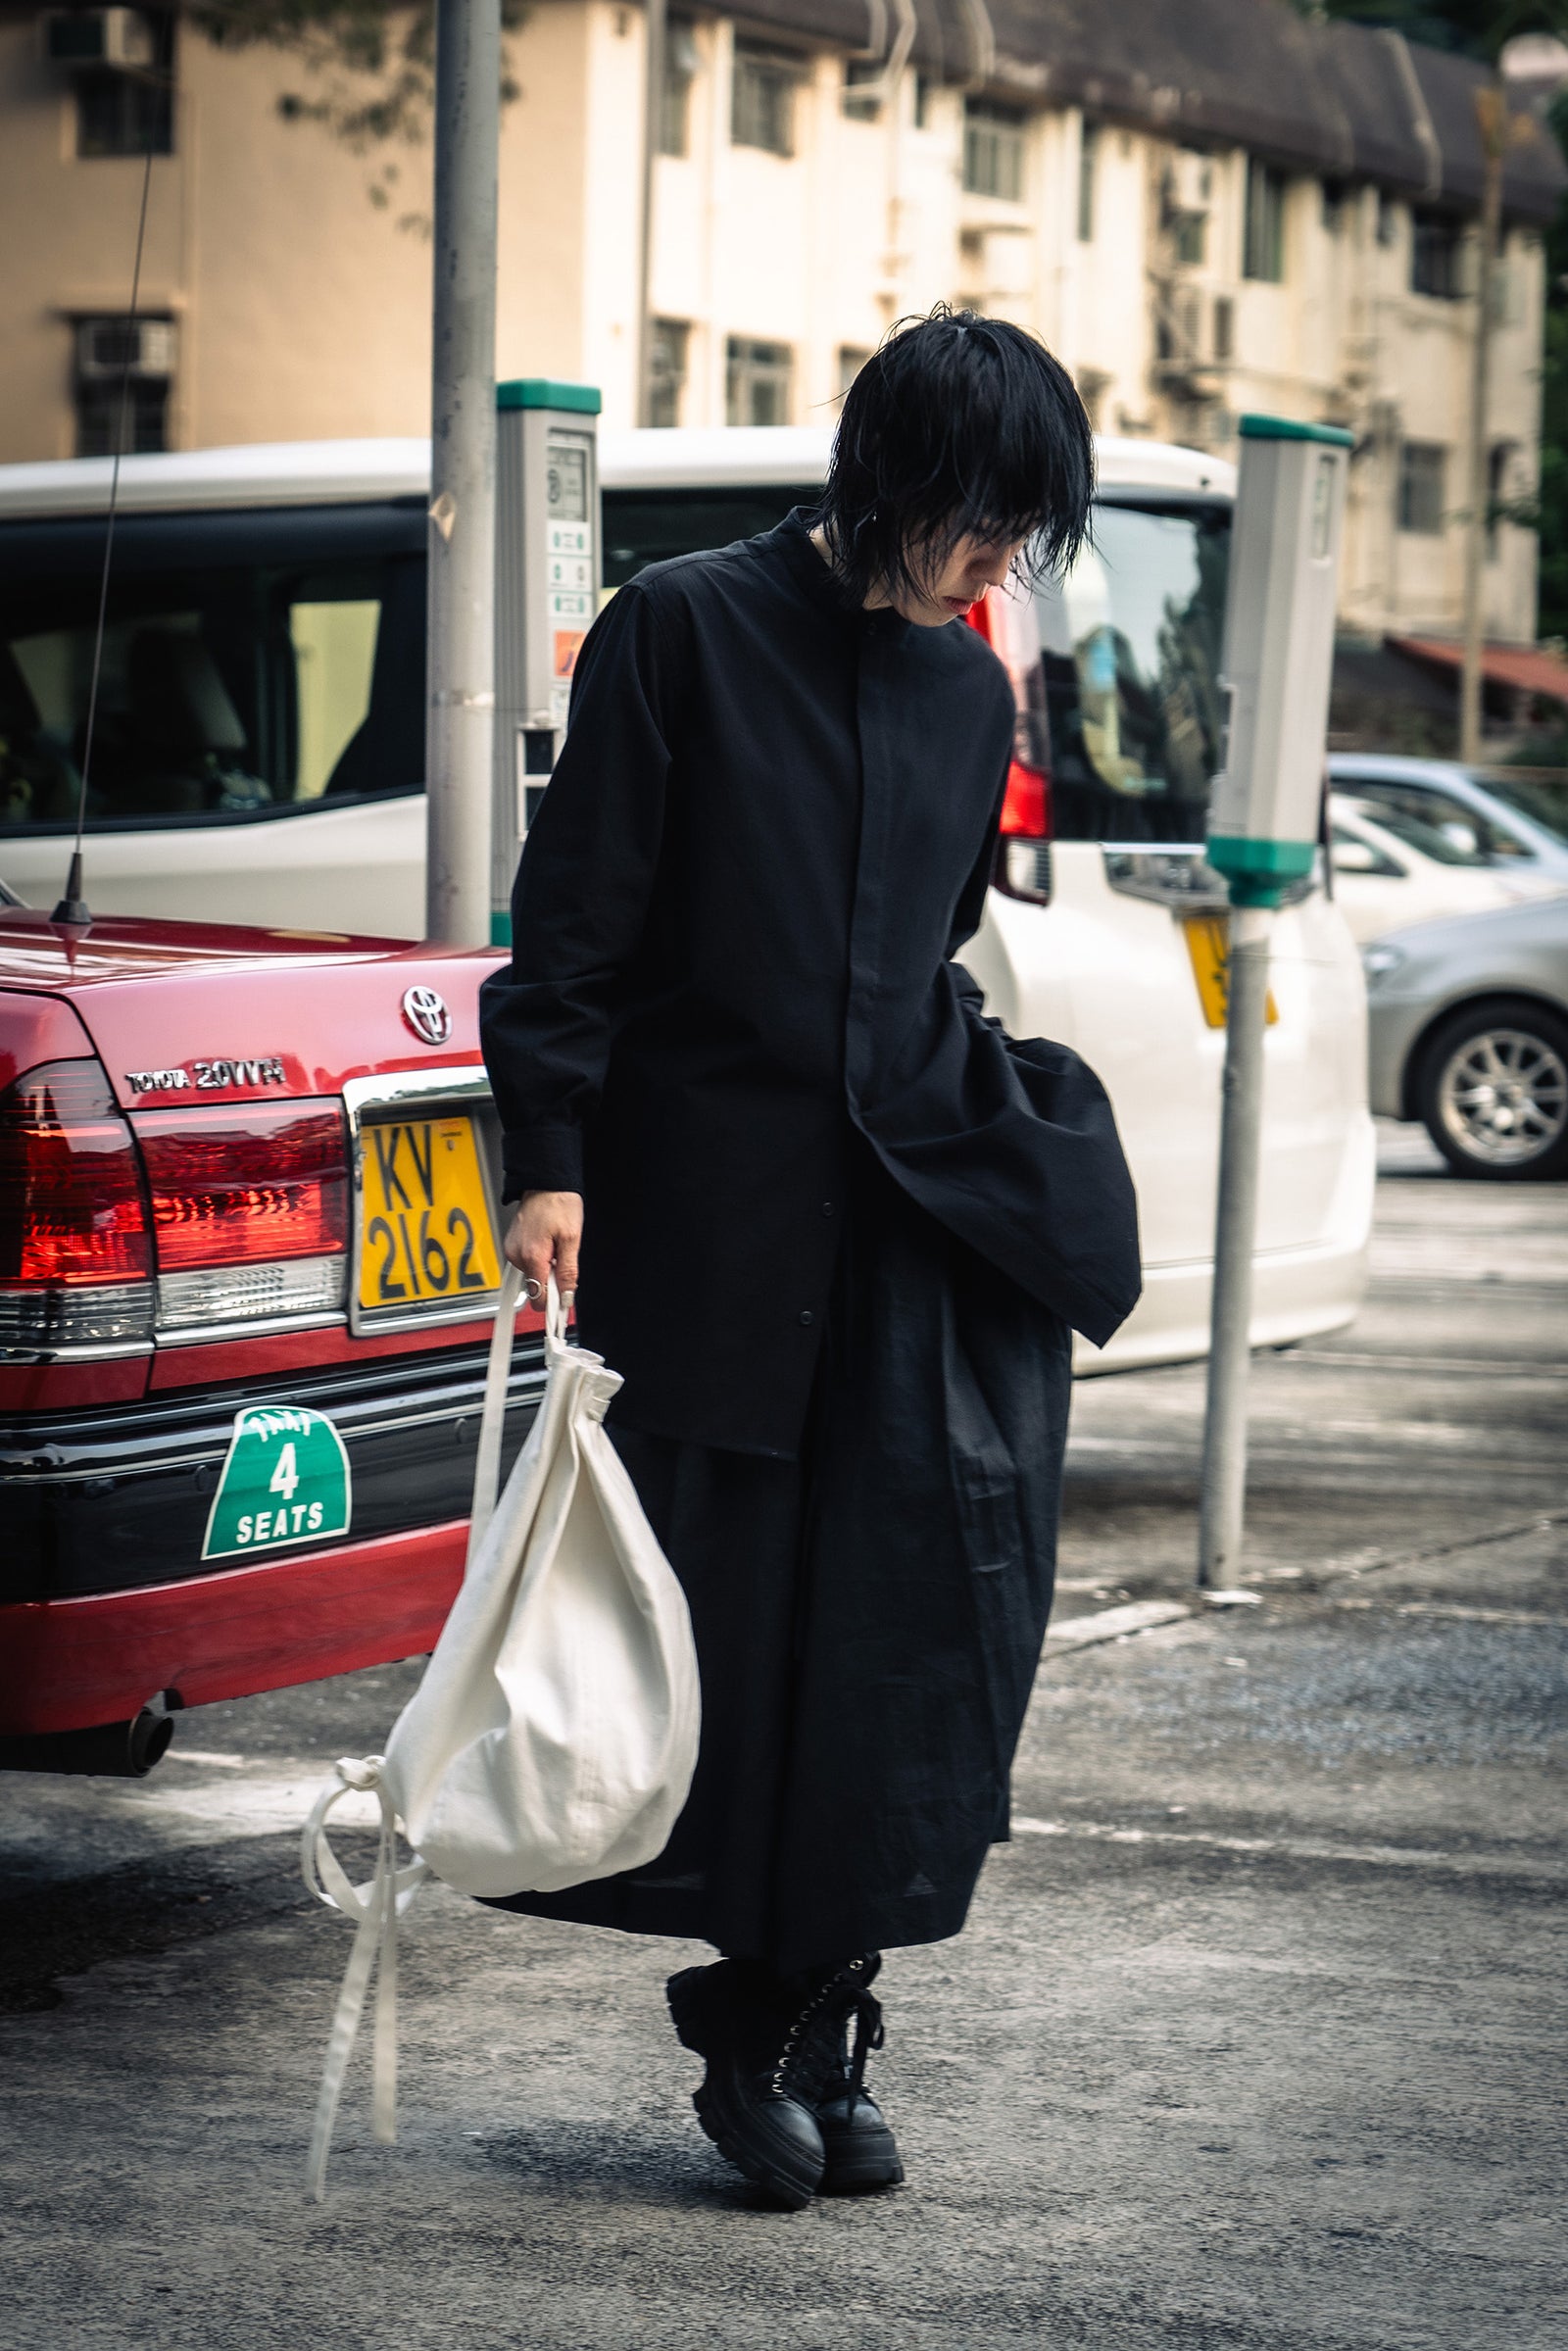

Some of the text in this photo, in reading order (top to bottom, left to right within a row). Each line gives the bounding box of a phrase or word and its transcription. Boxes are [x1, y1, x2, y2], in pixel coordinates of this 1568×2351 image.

[124, 1069, 191, 1094] TOYOTA
[373, 1124, 434, 1211] KV
[368, 1208, 486, 1300] 2162
[270, 1443, 300, 1499] 4
[236, 1502, 323, 1543] SEATS
